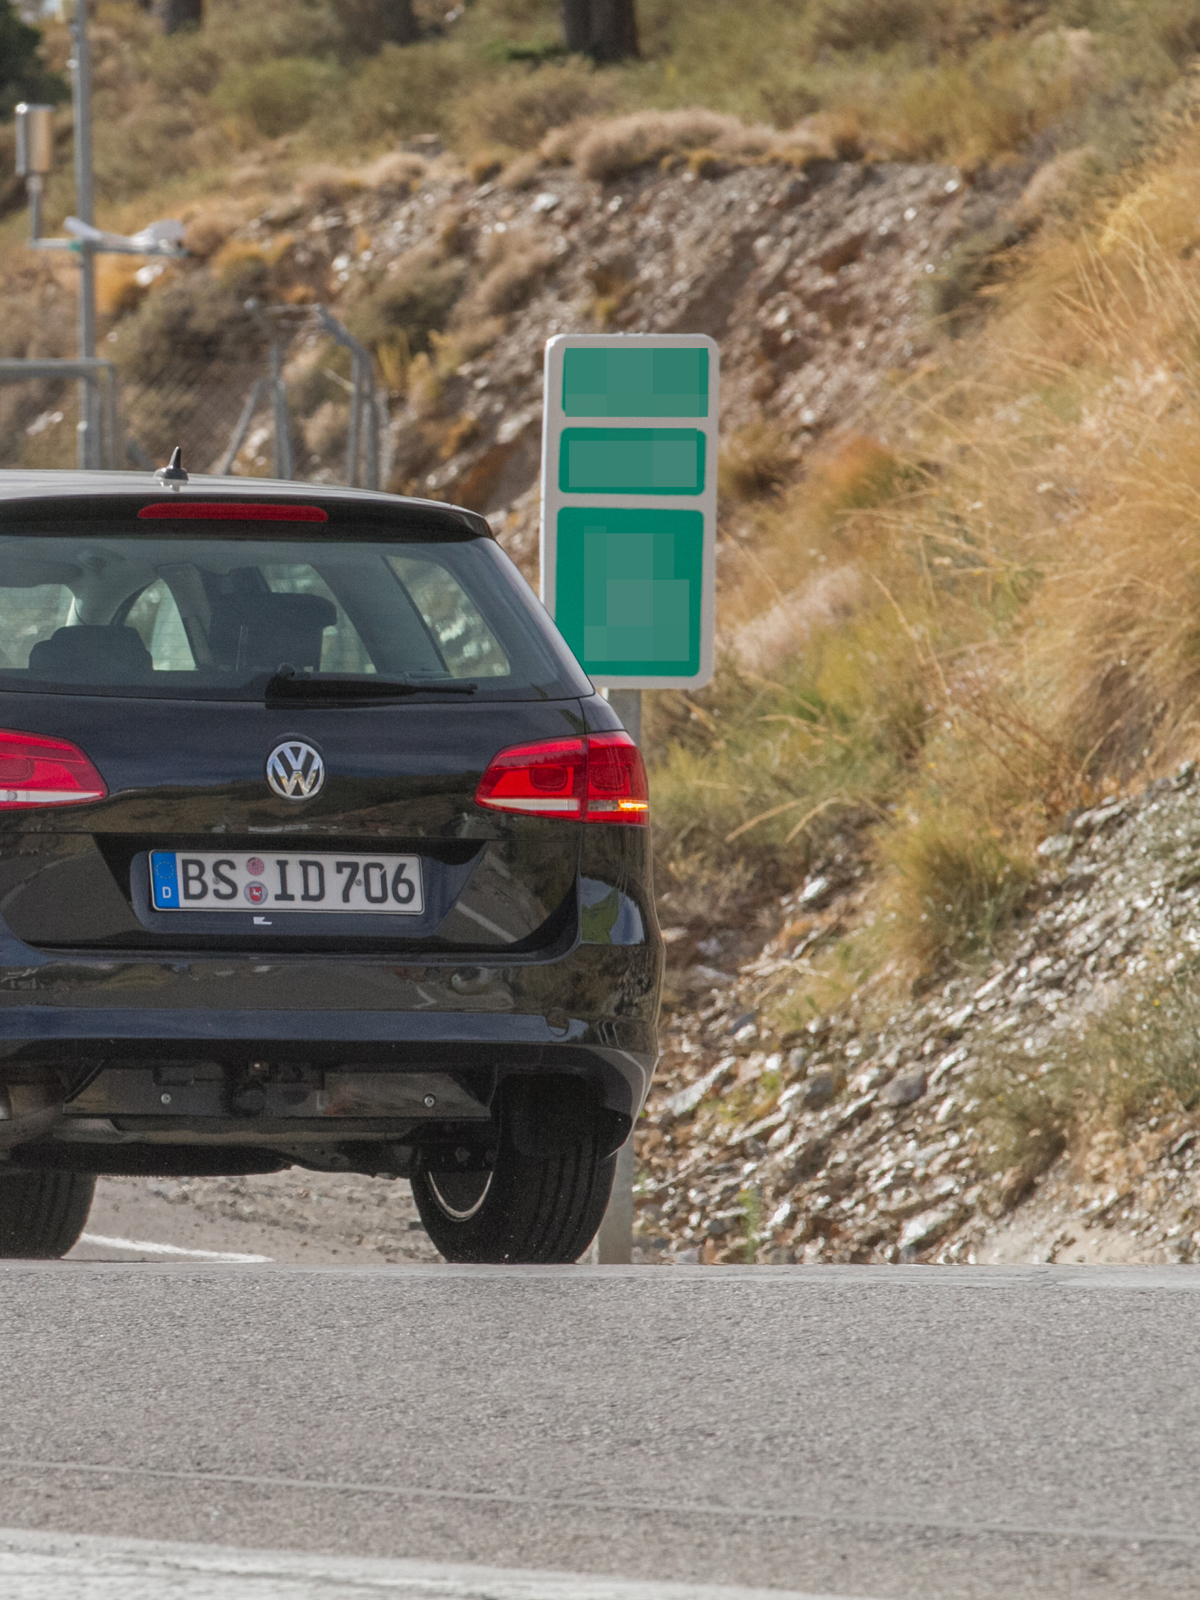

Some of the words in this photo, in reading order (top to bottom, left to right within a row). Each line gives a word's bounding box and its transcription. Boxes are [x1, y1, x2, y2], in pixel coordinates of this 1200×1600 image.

[267, 742, 325, 799] VW
[162, 886, 172, 899] D
[181, 858, 238, 901] BS
[274, 859, 326, 902] ID
[335, 861, 416, 905] 706
